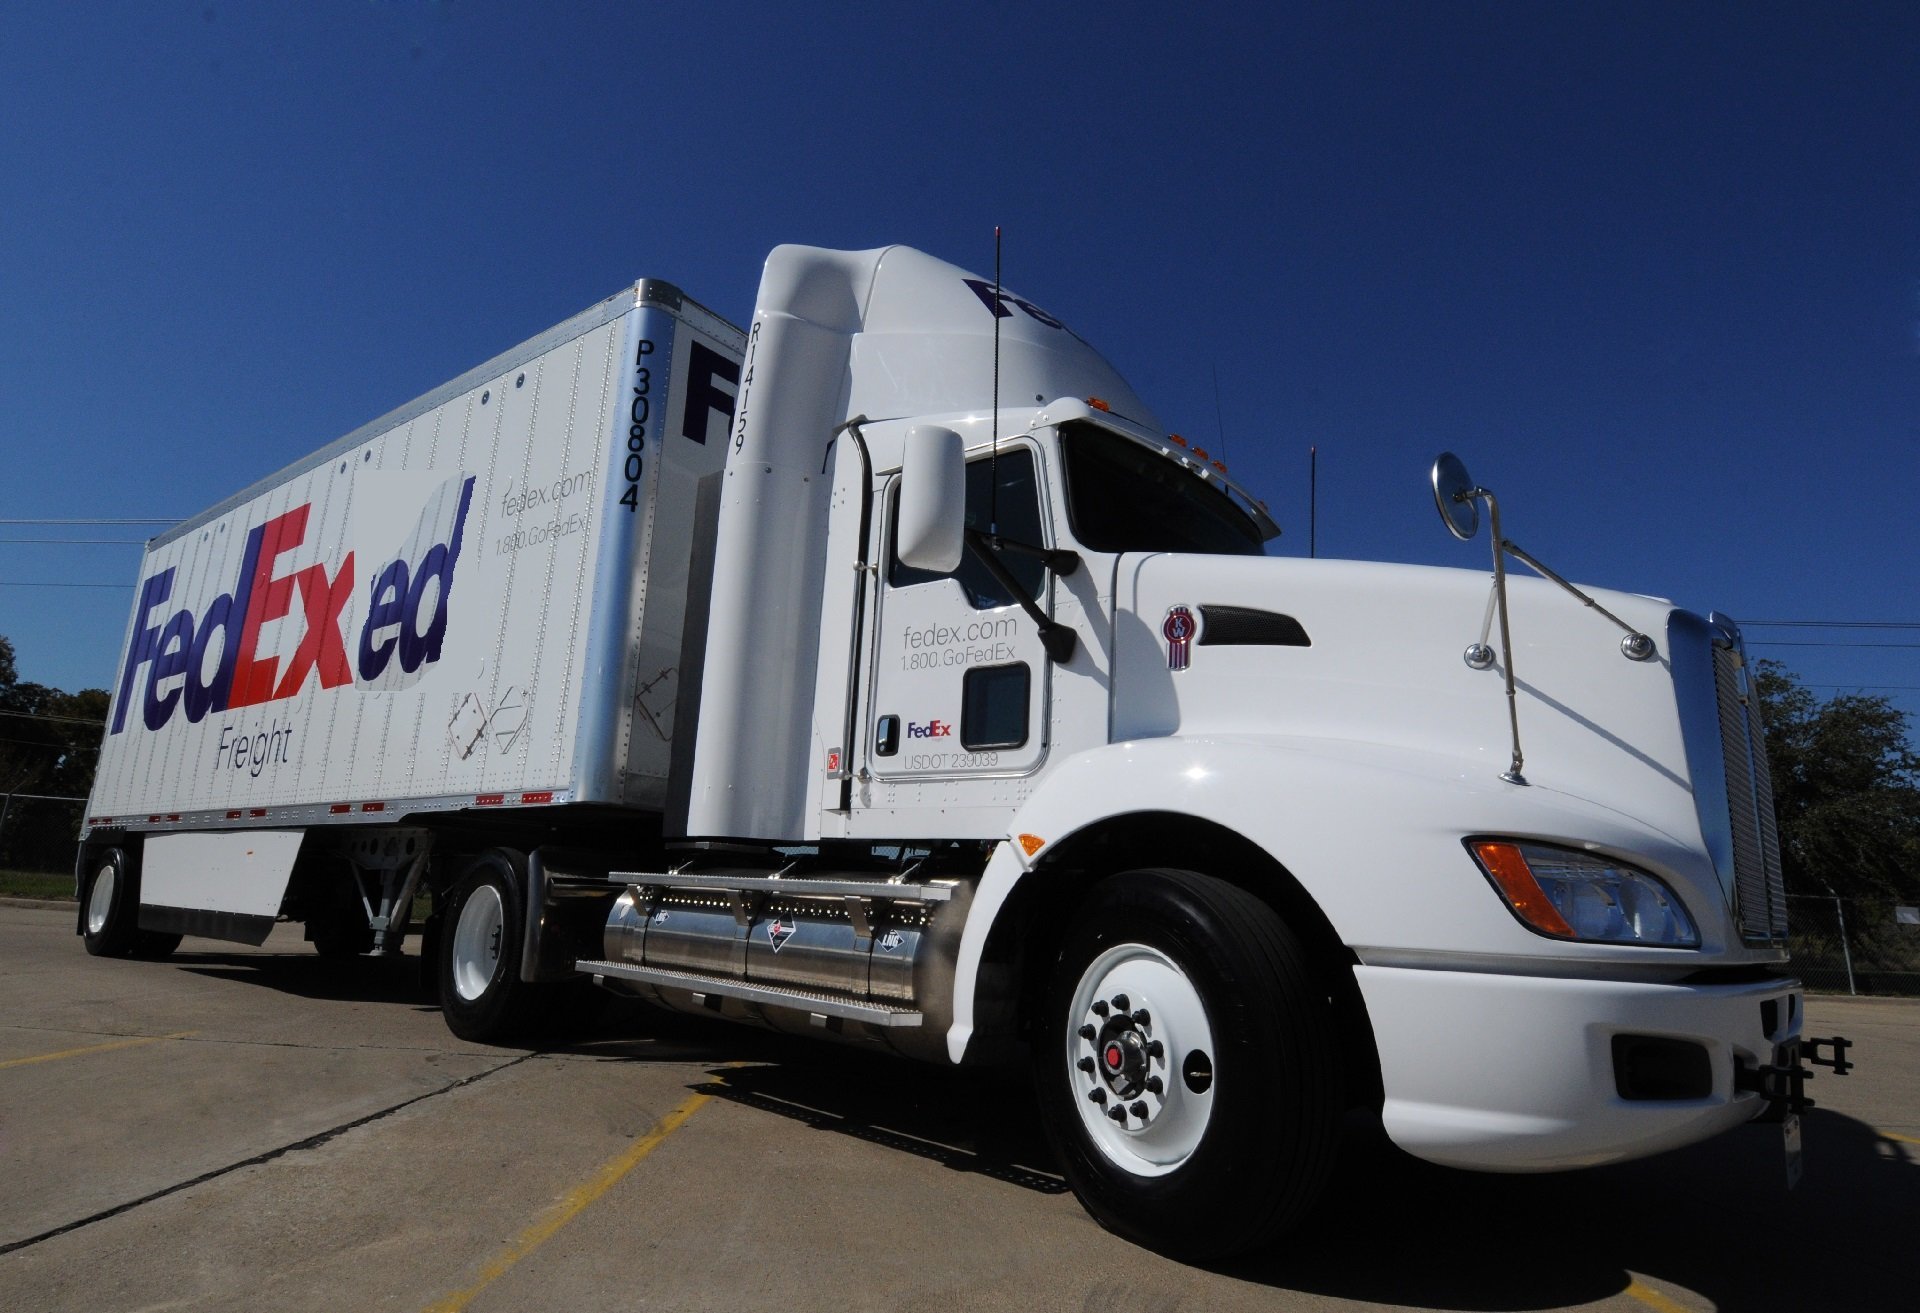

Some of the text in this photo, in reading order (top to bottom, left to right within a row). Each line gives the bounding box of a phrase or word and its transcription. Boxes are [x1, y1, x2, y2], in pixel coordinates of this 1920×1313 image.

[735, 322, 761, 455] R14159
[619, 340, 654, 512] P30804
[501, 471, 592, 518] fedex.com
[496, 513, 586, 556] 1.800.GoFedEx
[904, 618, 1017, 649] fedex.com
[901, 642, 1016, 671] 1.800.GoFedEx
[907, 720, 951, 738] FedEx
[216, 719, 293, 777] Freight
[904, 751, 999, 770] USDOT 239039
[882, 934, 899, 946] LNG
